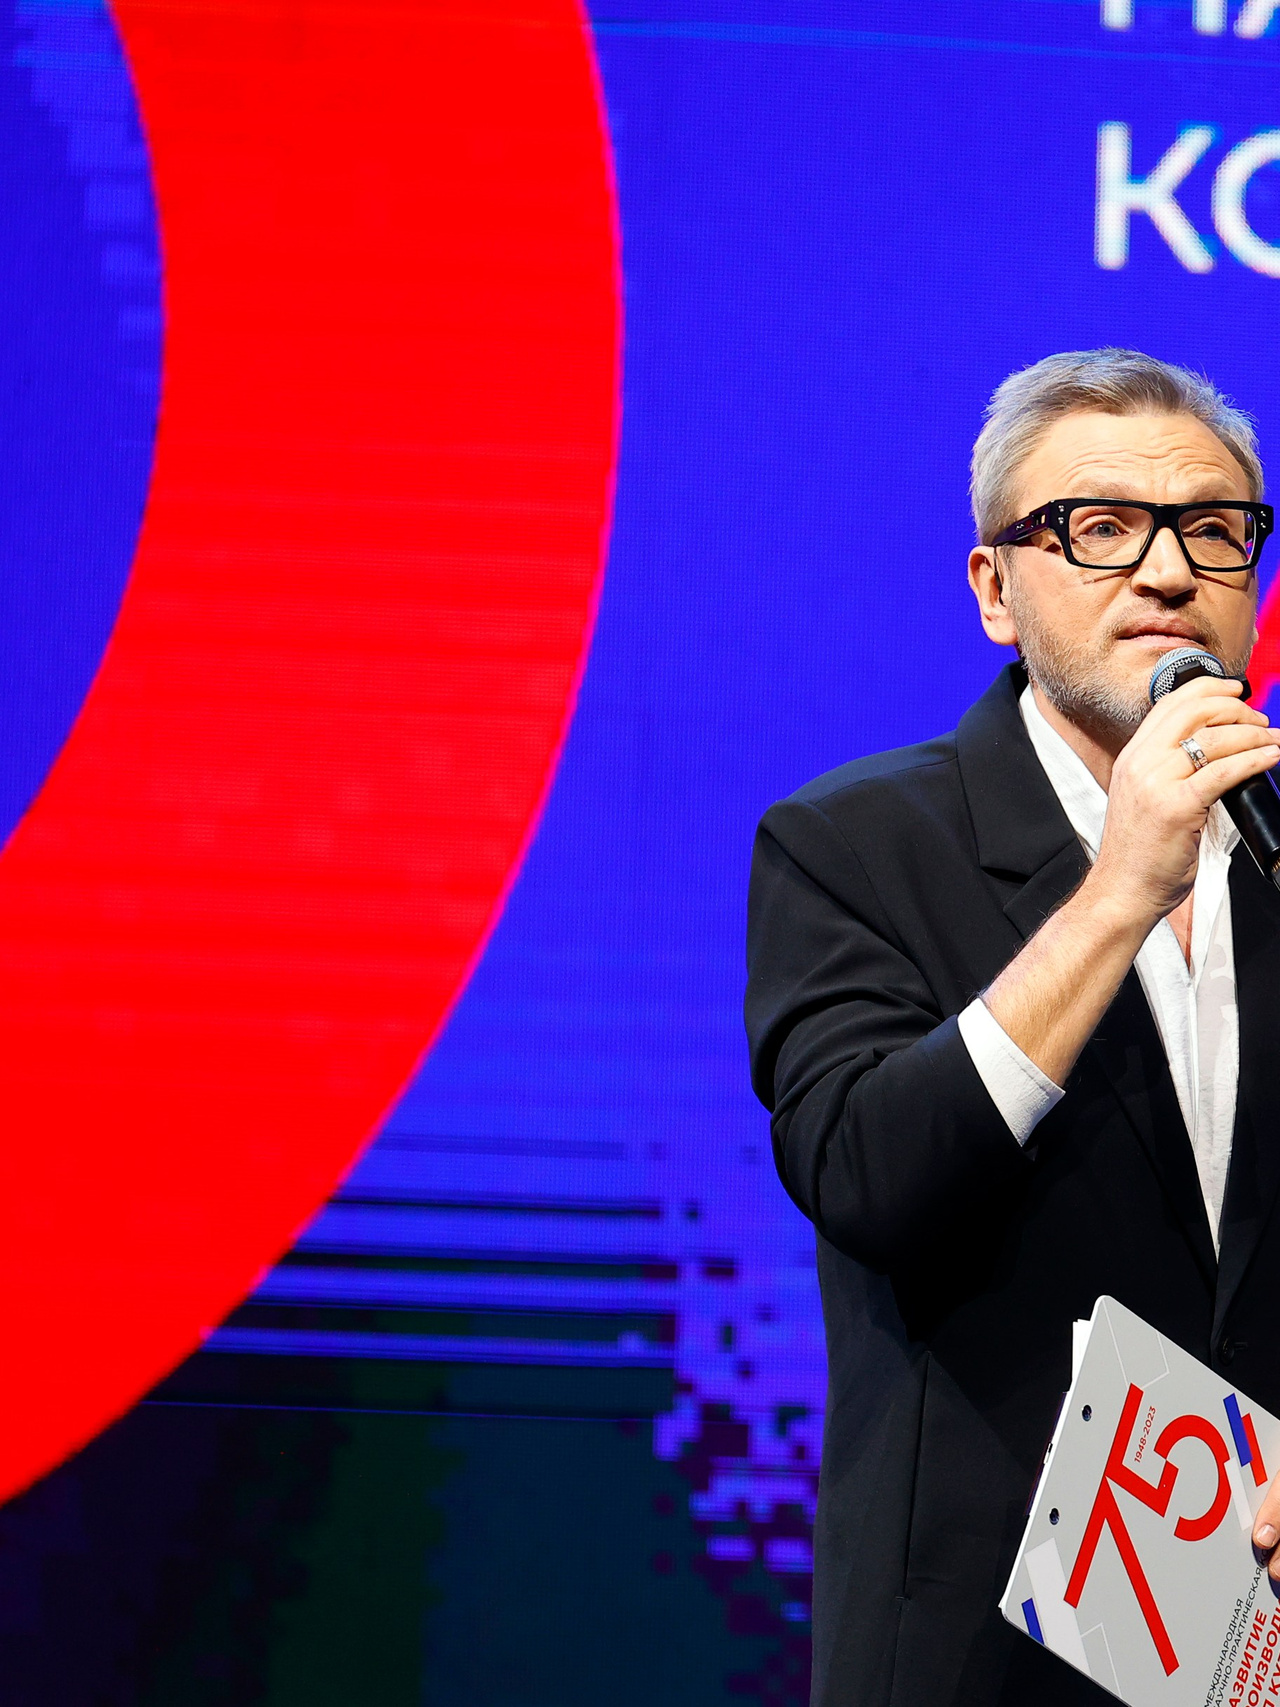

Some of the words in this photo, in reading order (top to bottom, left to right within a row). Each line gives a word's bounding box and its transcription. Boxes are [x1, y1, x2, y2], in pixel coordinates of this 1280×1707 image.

[1133, 1405, 1157, 1464] 1948-2023
[1204, 1598, 1244, 1707] МЕЖДУНАРОДНАЯ
[1213, 1566, 1263, 1707] АУЧНО-ПРАКТИЧЕСКАЯ
